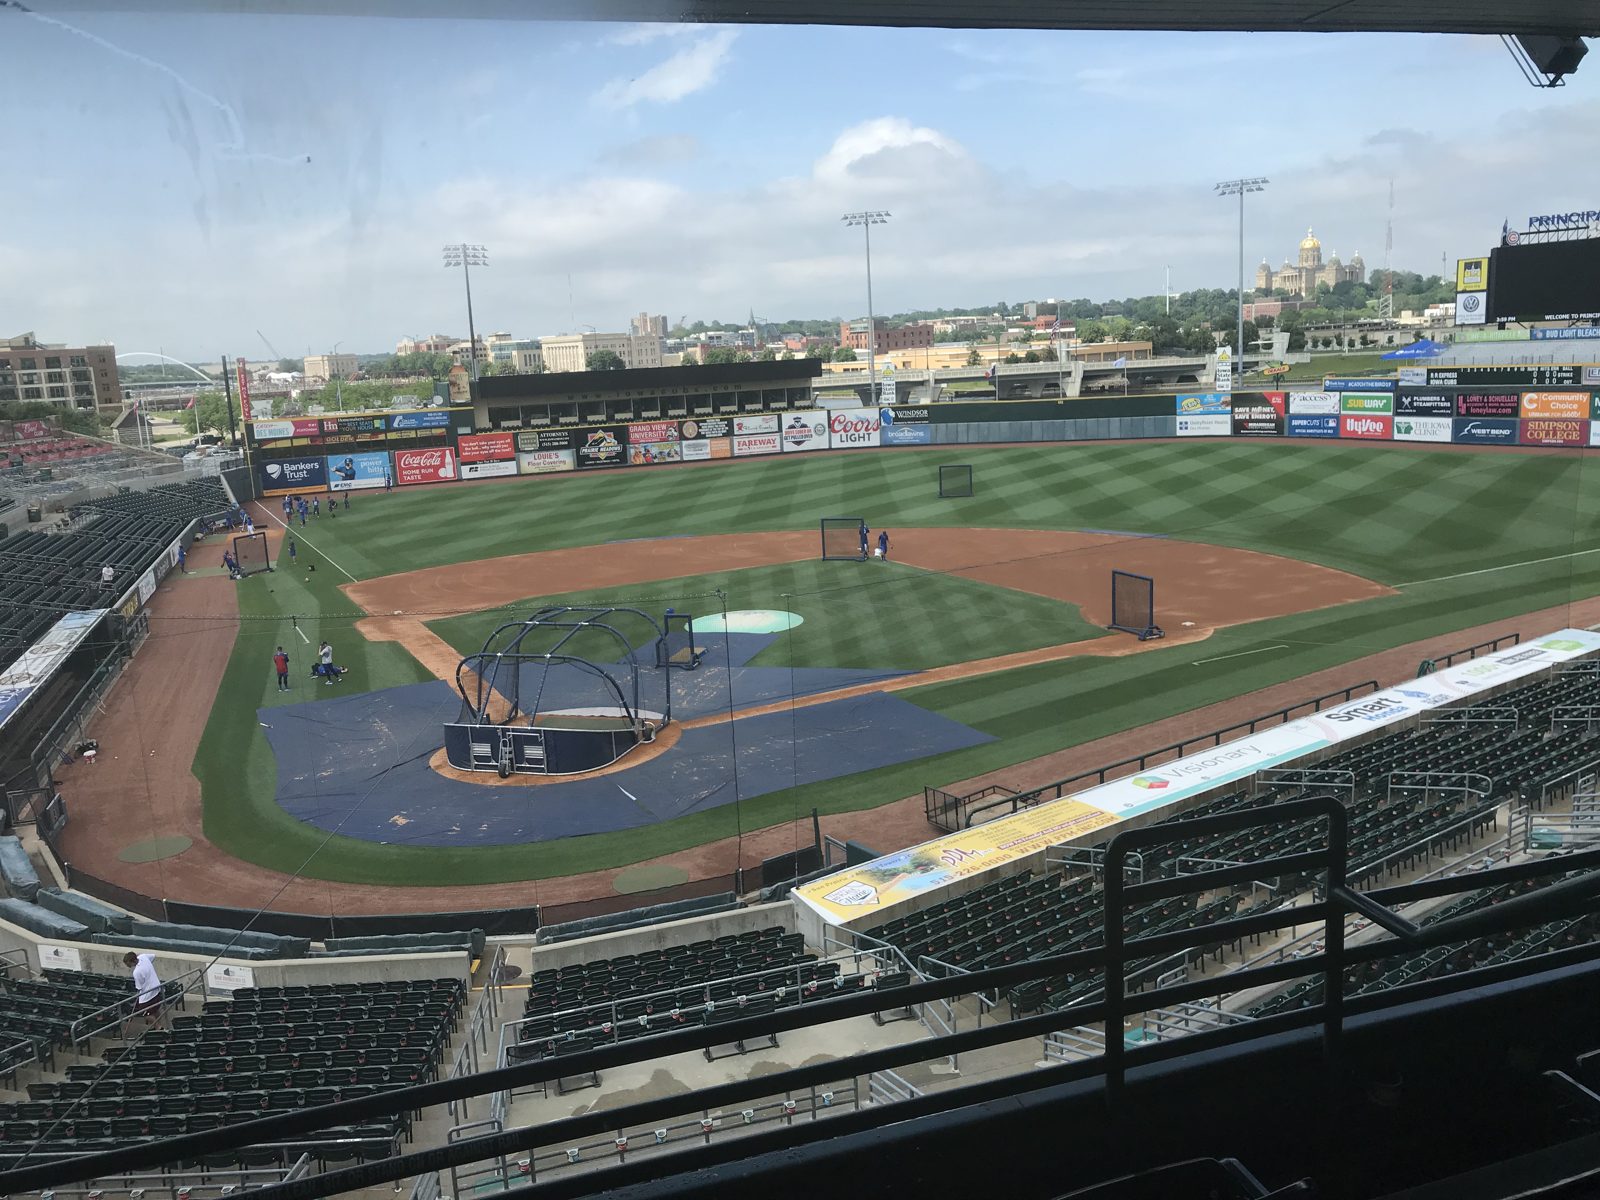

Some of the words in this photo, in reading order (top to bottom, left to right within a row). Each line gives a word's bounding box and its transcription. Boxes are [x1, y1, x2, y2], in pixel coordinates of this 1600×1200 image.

[1545, 330, 1558, 338] BUD
[1559, 328, 1577, 338] LIGHT
[1542, 393, 1587, 403] Community
[1347, 399, 1386, 409] SUBWAY
[1550, 401, 1578, 409] Choice
[896, 409, 929, 418] WINDSOR
[1470, 407, 1512, 415] loneylaw.com
[323, 421, 338, 431] Hm
[831, 414, 880, 434] Coors
[1429, 422, 1450, 430] IOWA
[1528, 421, 1580, 430] SIMPSON
[629, 425, 651, 433] GRAND
[630, 431, 666, 440] UNIVERSITY
[840, 433, 871, 443] LIGHT
[1527, 430, 1580, 440] COLLEGE
[737, 438, 777, 447] FAREWAY
[400, 451, 443, 468] Coca-Cola
[533, 452, 560, 461] LOUIE'S
[283, 462, 320, 471] Bankers
[360, 460, 382, 469] power
[284, 470, 310, 479] Trust.
[1325, 698, 1403, 722] Smart
[1362, 706, 1409, 721] Honda
[1160, 743, 1262, 778] Visionary
